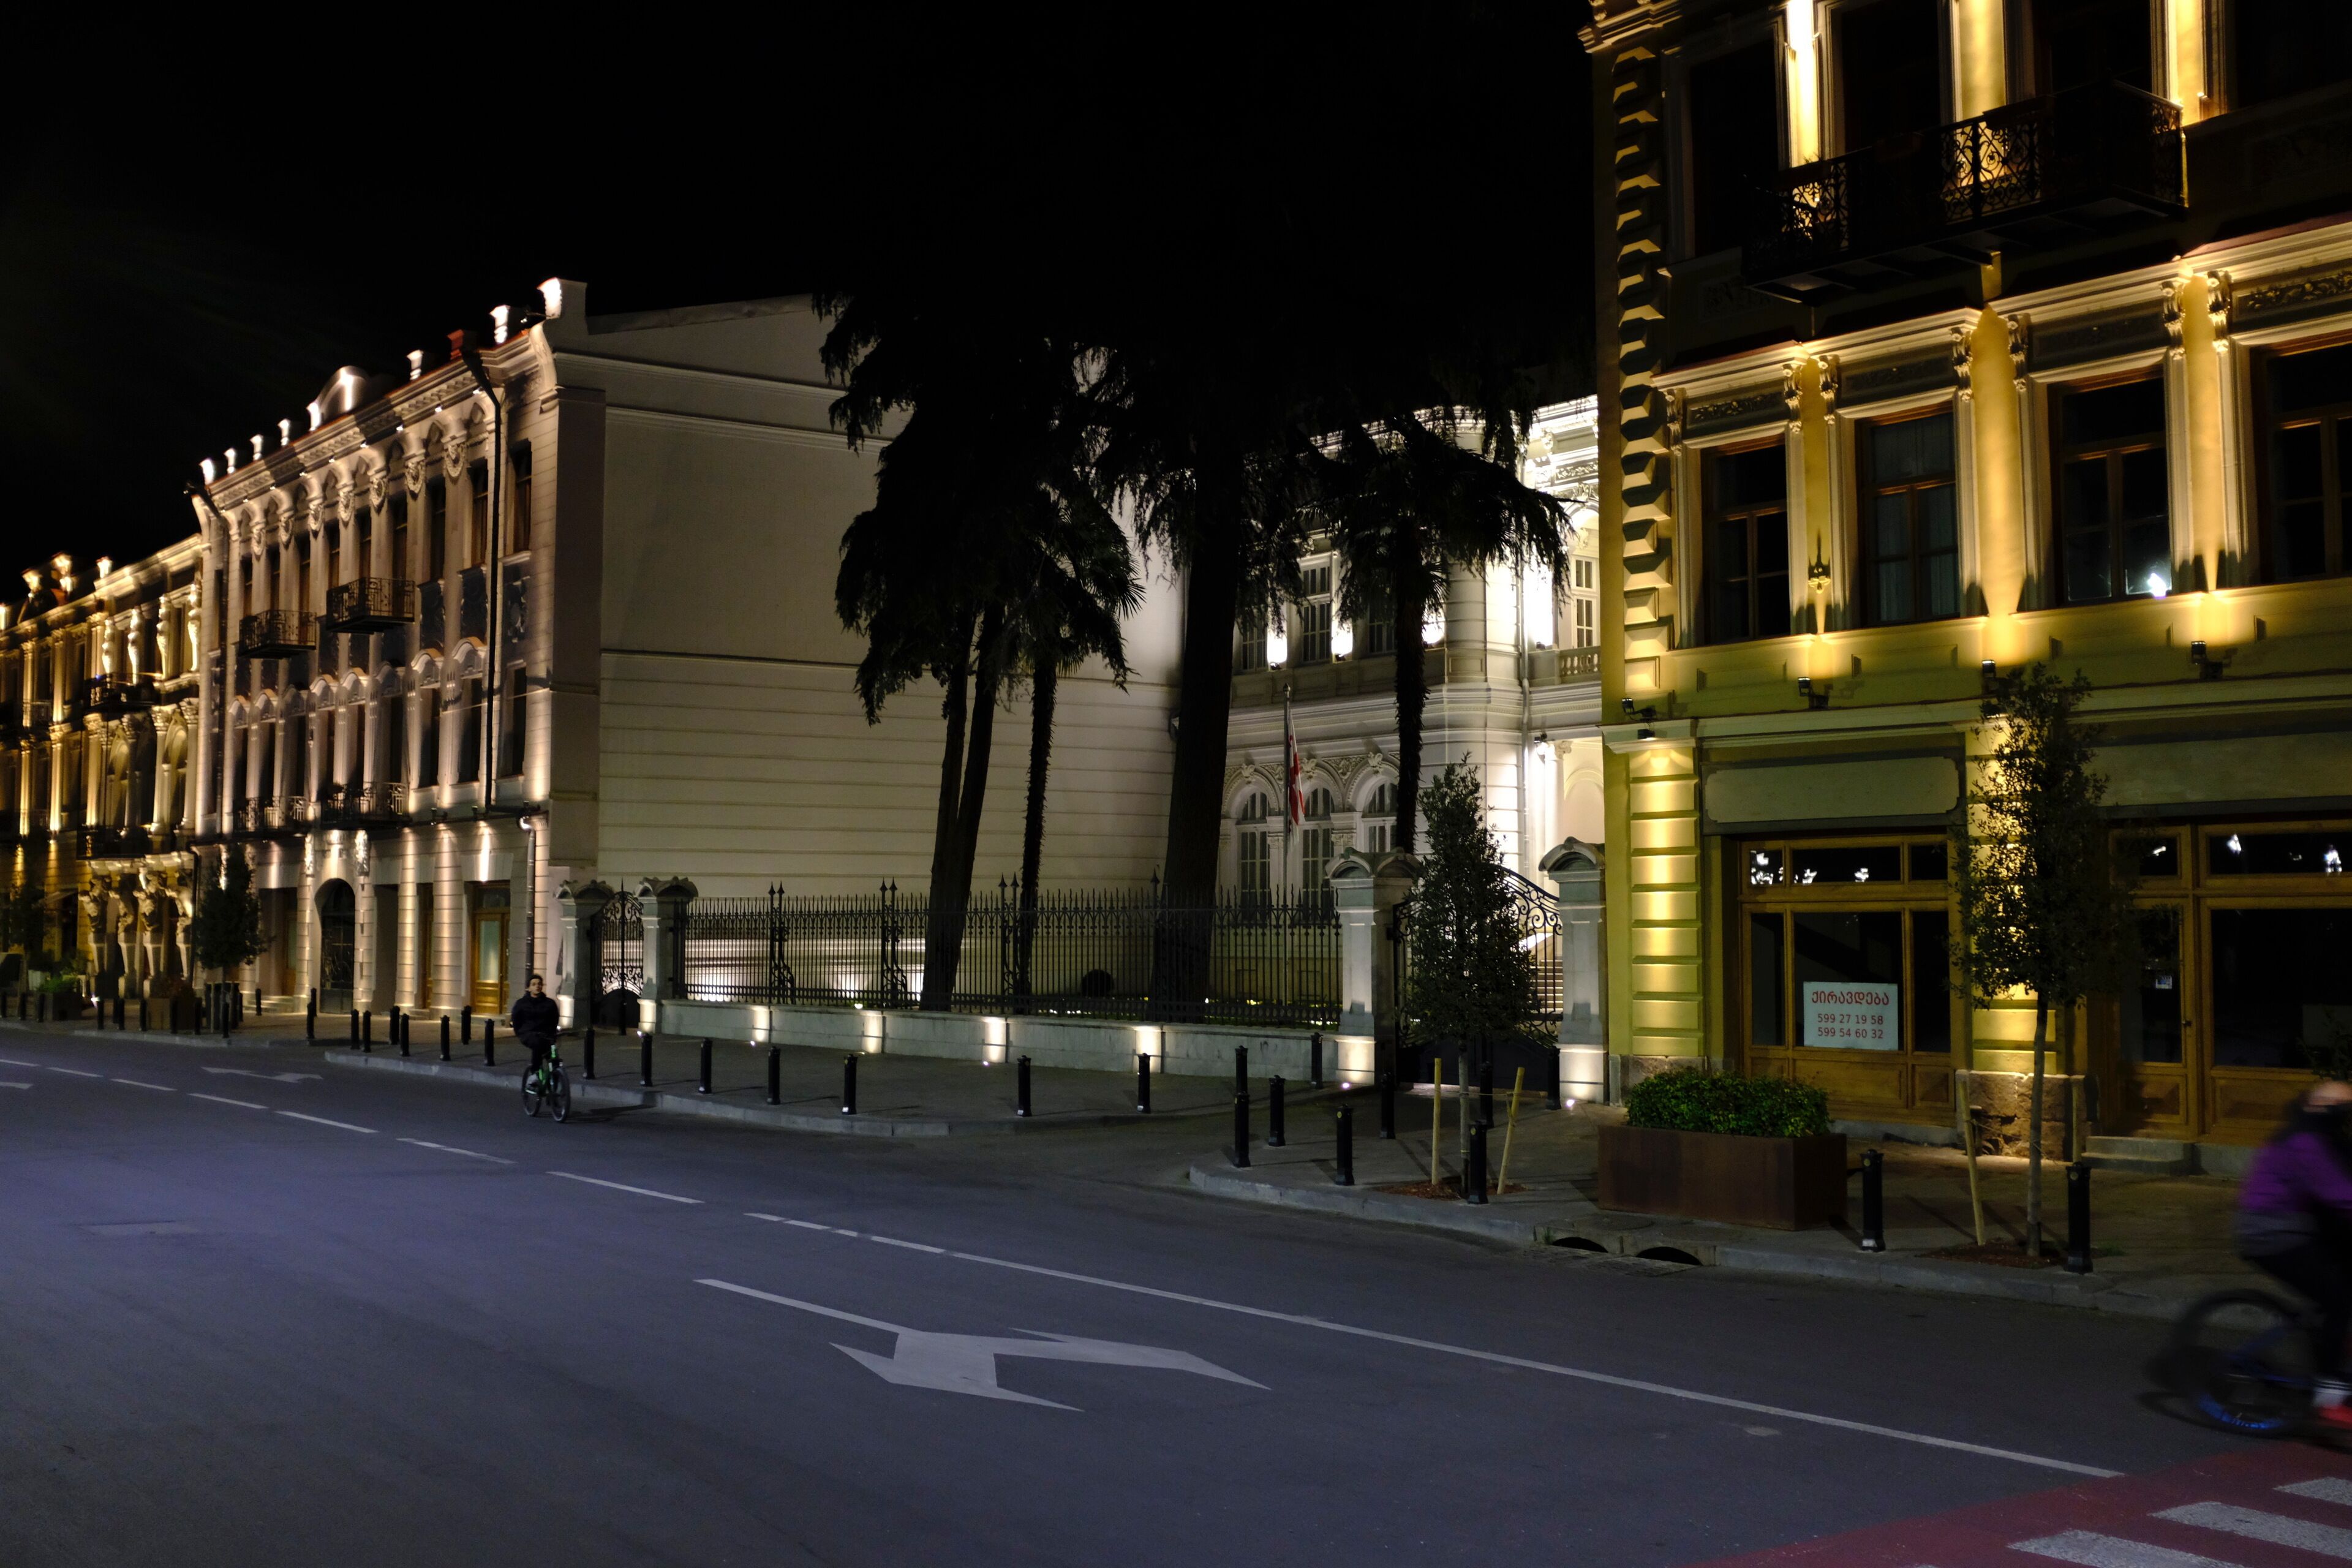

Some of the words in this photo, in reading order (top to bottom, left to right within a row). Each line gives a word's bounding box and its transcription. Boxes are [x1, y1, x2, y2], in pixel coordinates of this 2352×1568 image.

[1812, 990, 1890, 1006] ქირავდება
[1818, 1013, 1836, 1023] 599
[1839, 1014, 1851, 1023] 27
[1855, 1014, 1867, 1024] 19
[1871, 1015, 1883, 1025] 58
[1818, 1027, 1836, 1036] 599
[1839, 1028, 1851, 1037] 54
[1855, 1028, 1867, 1038] 60
[1871, 1029, 1883, 1039] 32
